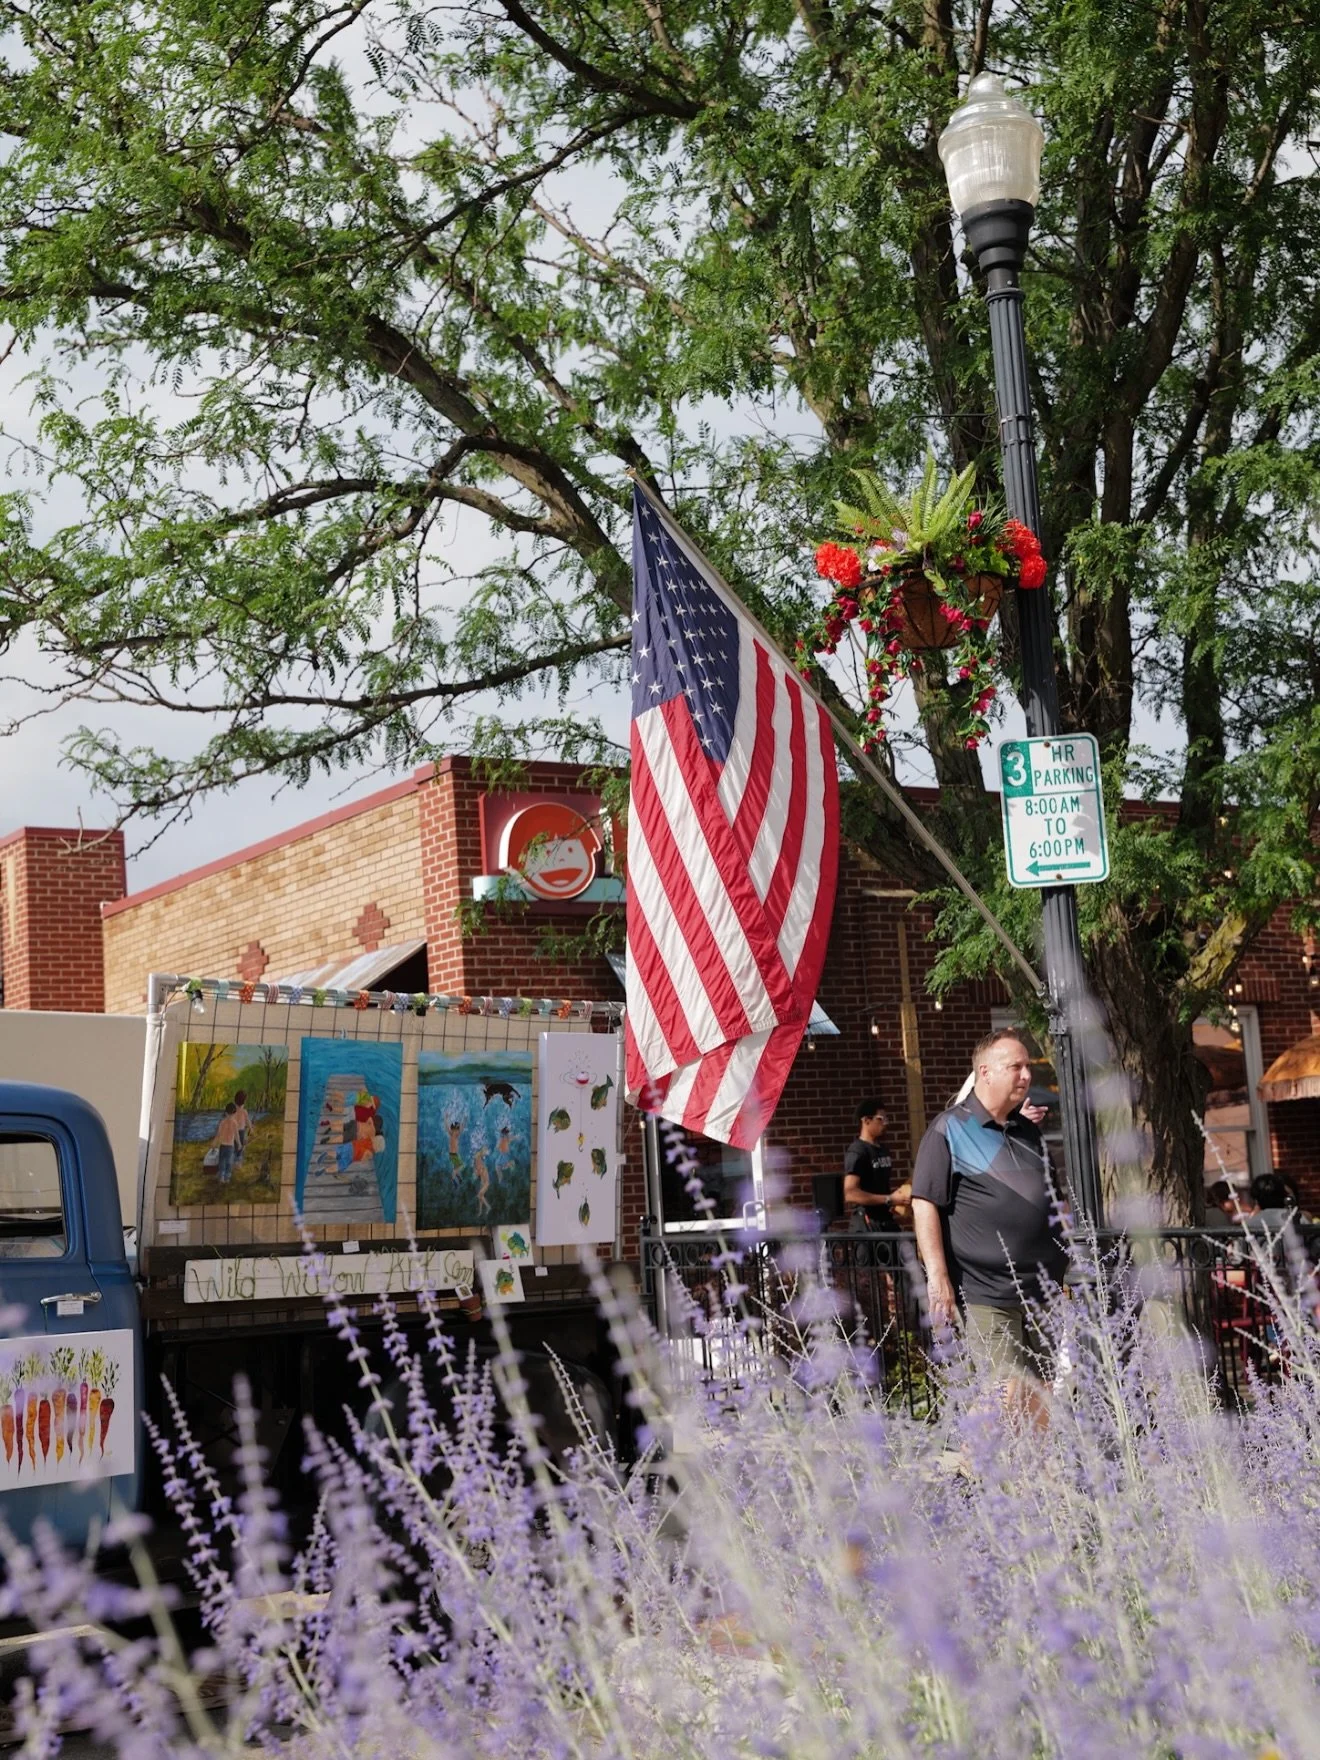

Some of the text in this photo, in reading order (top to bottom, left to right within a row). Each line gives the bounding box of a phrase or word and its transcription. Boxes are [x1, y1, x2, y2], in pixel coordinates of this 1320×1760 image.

[1051, 744, 1075, 762] HR
[1006, 751, 1027, 786] 3
[1034, 767, 1093, 786] PARKING
[1044, 817, 1066, 836] TO
[190, 1246, 262, 1302] Wild
